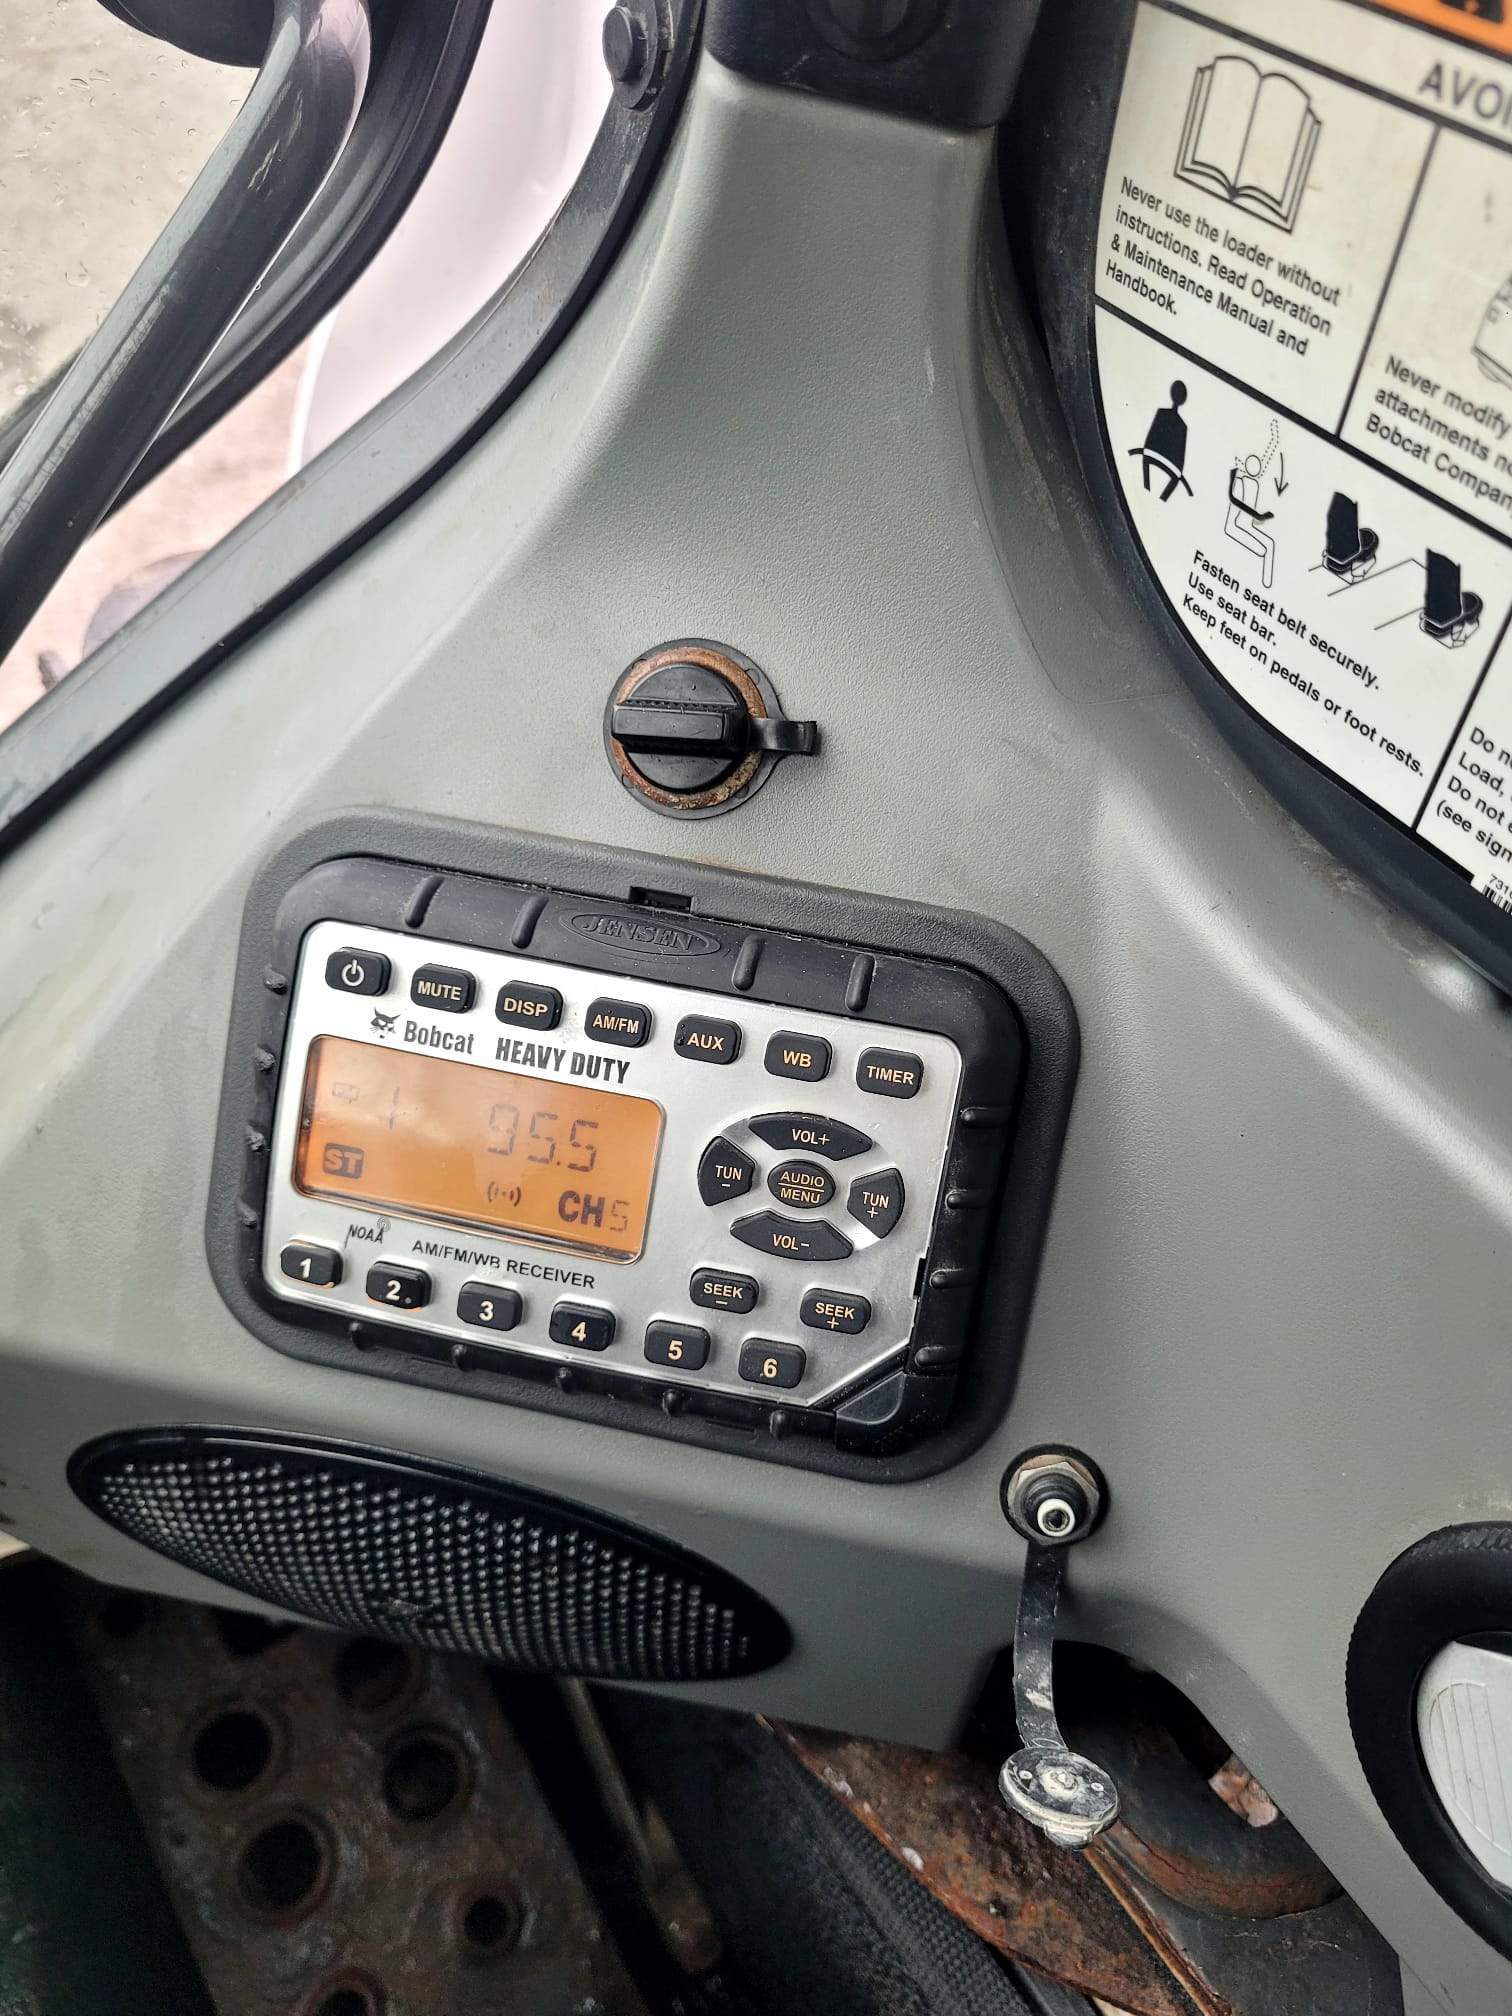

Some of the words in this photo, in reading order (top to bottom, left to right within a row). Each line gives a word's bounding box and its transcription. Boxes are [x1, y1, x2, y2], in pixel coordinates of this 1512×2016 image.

[1121, 177, 1162, 211] Never
[1165, 202, 1191, 228] use
[1195, 217, 1219, 243] the
[1223, 230, 1273, 270] loader
[1278, 262, 1341, 306] without
[1115, 205, 1202, 267] instructions.
[1207, 255, 1248, 290] Read
[1251, 279, 1332, 336] Operation
[1106, 259, 1177, 315] Handbook.
[1110, 233, 1121, 252] &
[1124, 240, 1213, 304] Maintenance
[1217, 291, 1274, 337] Manual
[1276, 329, 1309, 356] and
[1384, 354, 1441, 399] Never
[1443, 391, 1512, 440] modify
[1375, 388, 1490, 461] attachments
[1366, 413, 1431, 464] Bobcat
[1434, 453, 1512, 518] Compan
[1188, 571, 1214, 600] Use
[1217, 596, 1247, 624] seat
[1250, 615, 1276, 646] bar.
[1193, 549, 1240, 593] Fasten
[1243, 588, 1275, 617] seat
[1277, 607, 1307, 639] belt
[1309, 633, 1379, 690] securely.
[1183, 593, 1217, 628] Keep
[1220, 620, 1246, 650] feet
[1249, 645, 1267, 664] on
[1270, 660, 1320, 701] pedals
[1324, 698, 1341, 715] or
[1344, 709, 1377, 742] foot
[1379, 737, 1424, 777] rests.
[1469, 726, 1494, 753] Do
[1458, 751, 1504, 798] Load,
[1447, 775, 1471, 801] Do
[1475, 798, 1505, 826] not
[1436, 799, 1472, 832] (see
[582, 916, 693, 950] JENSEN
[417, 980, 462, 1001] MUTE
[503, 997, 549, 1017] DISP
[403, 1020, 475, 1055] Bobcat
[592, 1014, 640, 1034] AM/FM
[687, 1032, 724, 1051] AUX
[495, 1037, 567, 1072] HEAVY
[569, 1052, 631, 1084] DUTY
[783, 1050, 812, 1068] WB
[866, 1065, 914, 1085] TIMER
[487, 1103, 600, 1173] 95.5
[325, 1147, 363, 1176] ST
[715, 1165, 742, 1181] TUN
[780, 1171, 825, 1187] AUDIO
[780, 1188, 821, 1204] MENU
[862, 1191, 889, 1208] TUN
[557, 1190, 605, 1228] CH
[610, 1199, 630, 1232] 5
[345, 1224, 385, 1248] NOAA
[299, 1257, 312, 1278] 1
[411, 1240, 500, 1269] AM/FM/WB
[506, 1260, 595, 1289] RECEIVER
[387, 1279, 401, 1301] 2
[703, 1282, 744, 1299] SEEK
[479, 1300, 495, 1321] 3
[815, 1302, 856, 1320] SEEK
[571, 1321, 587, 1342] 4
[668, 1340, 684, 1361] 5
[763, 1358, 778, 1378] 6
